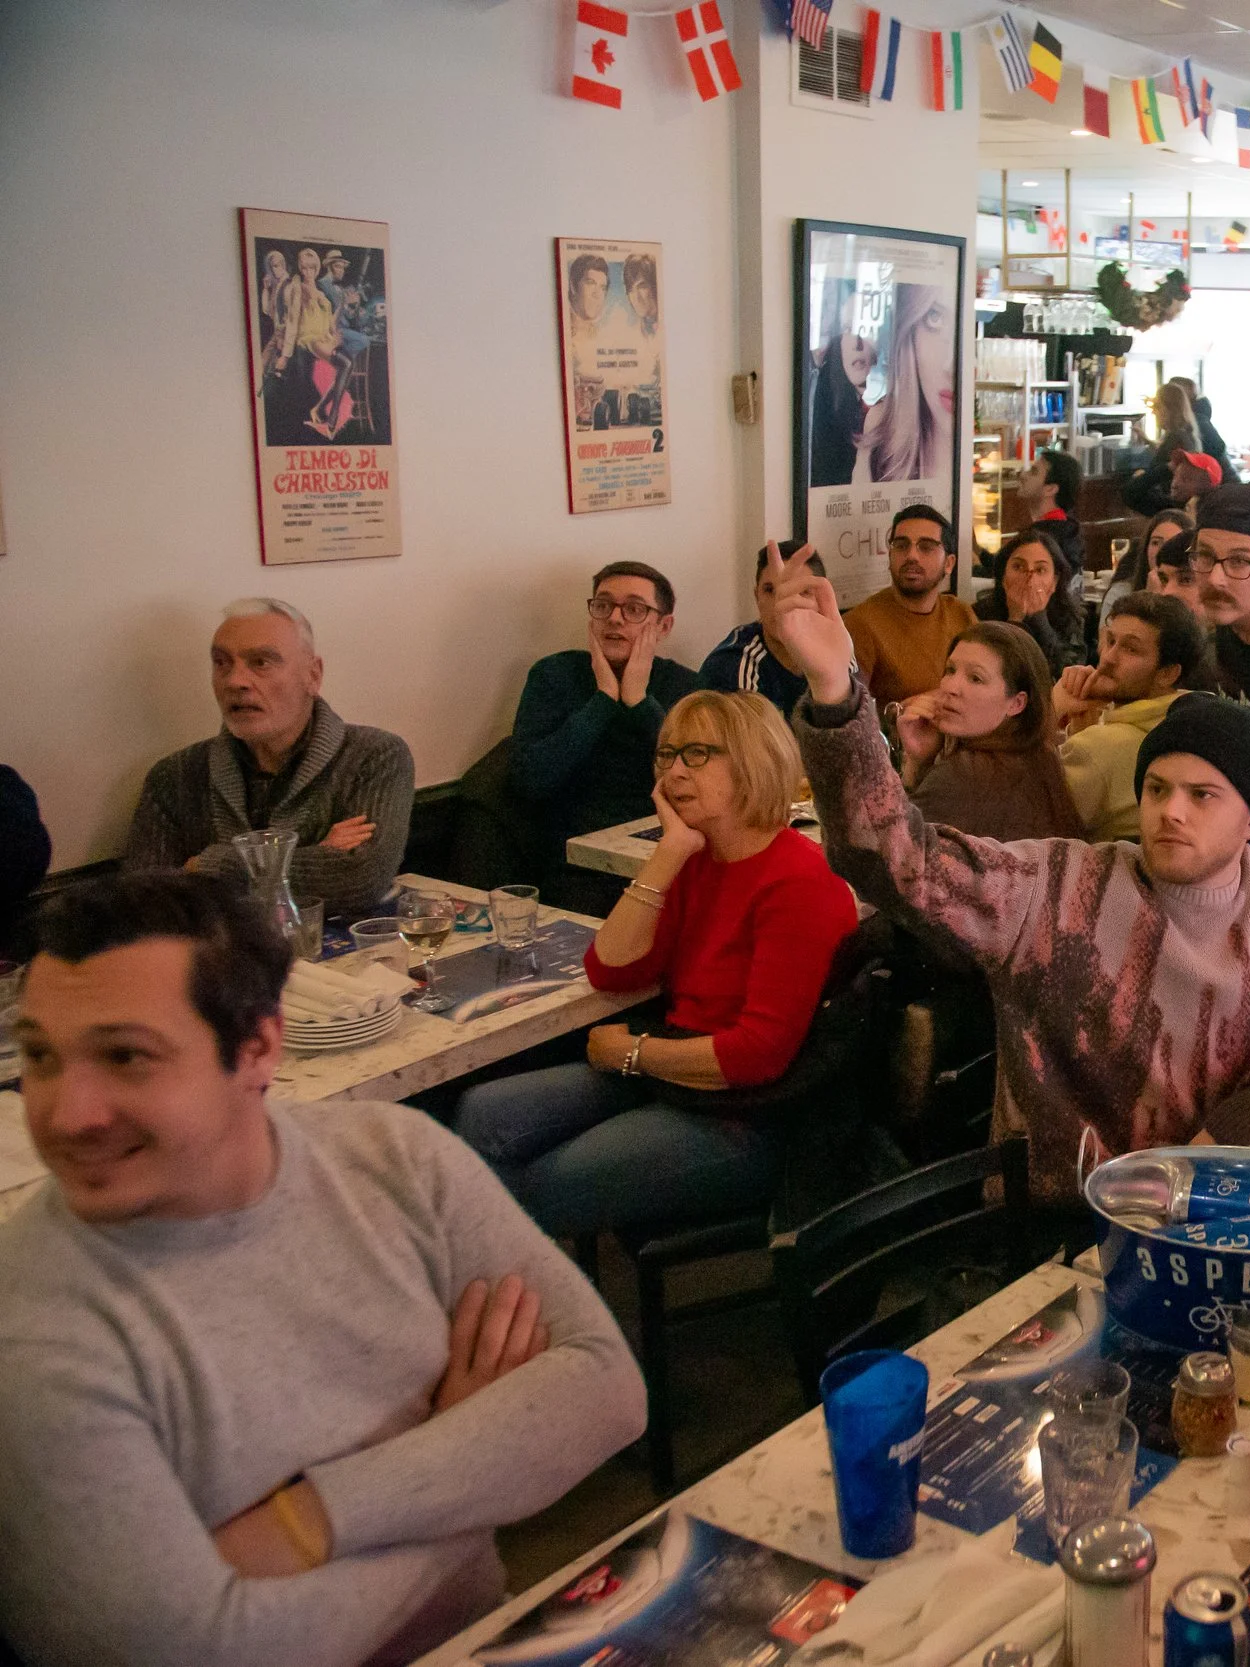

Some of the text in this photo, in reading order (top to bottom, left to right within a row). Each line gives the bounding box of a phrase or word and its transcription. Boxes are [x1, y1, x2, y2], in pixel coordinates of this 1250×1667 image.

[652, 428, 664, 453] 2
[285, 449, 352, 471] TEMPO
[273, 470, 389, 494] CHARLESTON
[825, 501, 852, 518] MOORE
[861, 499, 890, 515] NEESON
